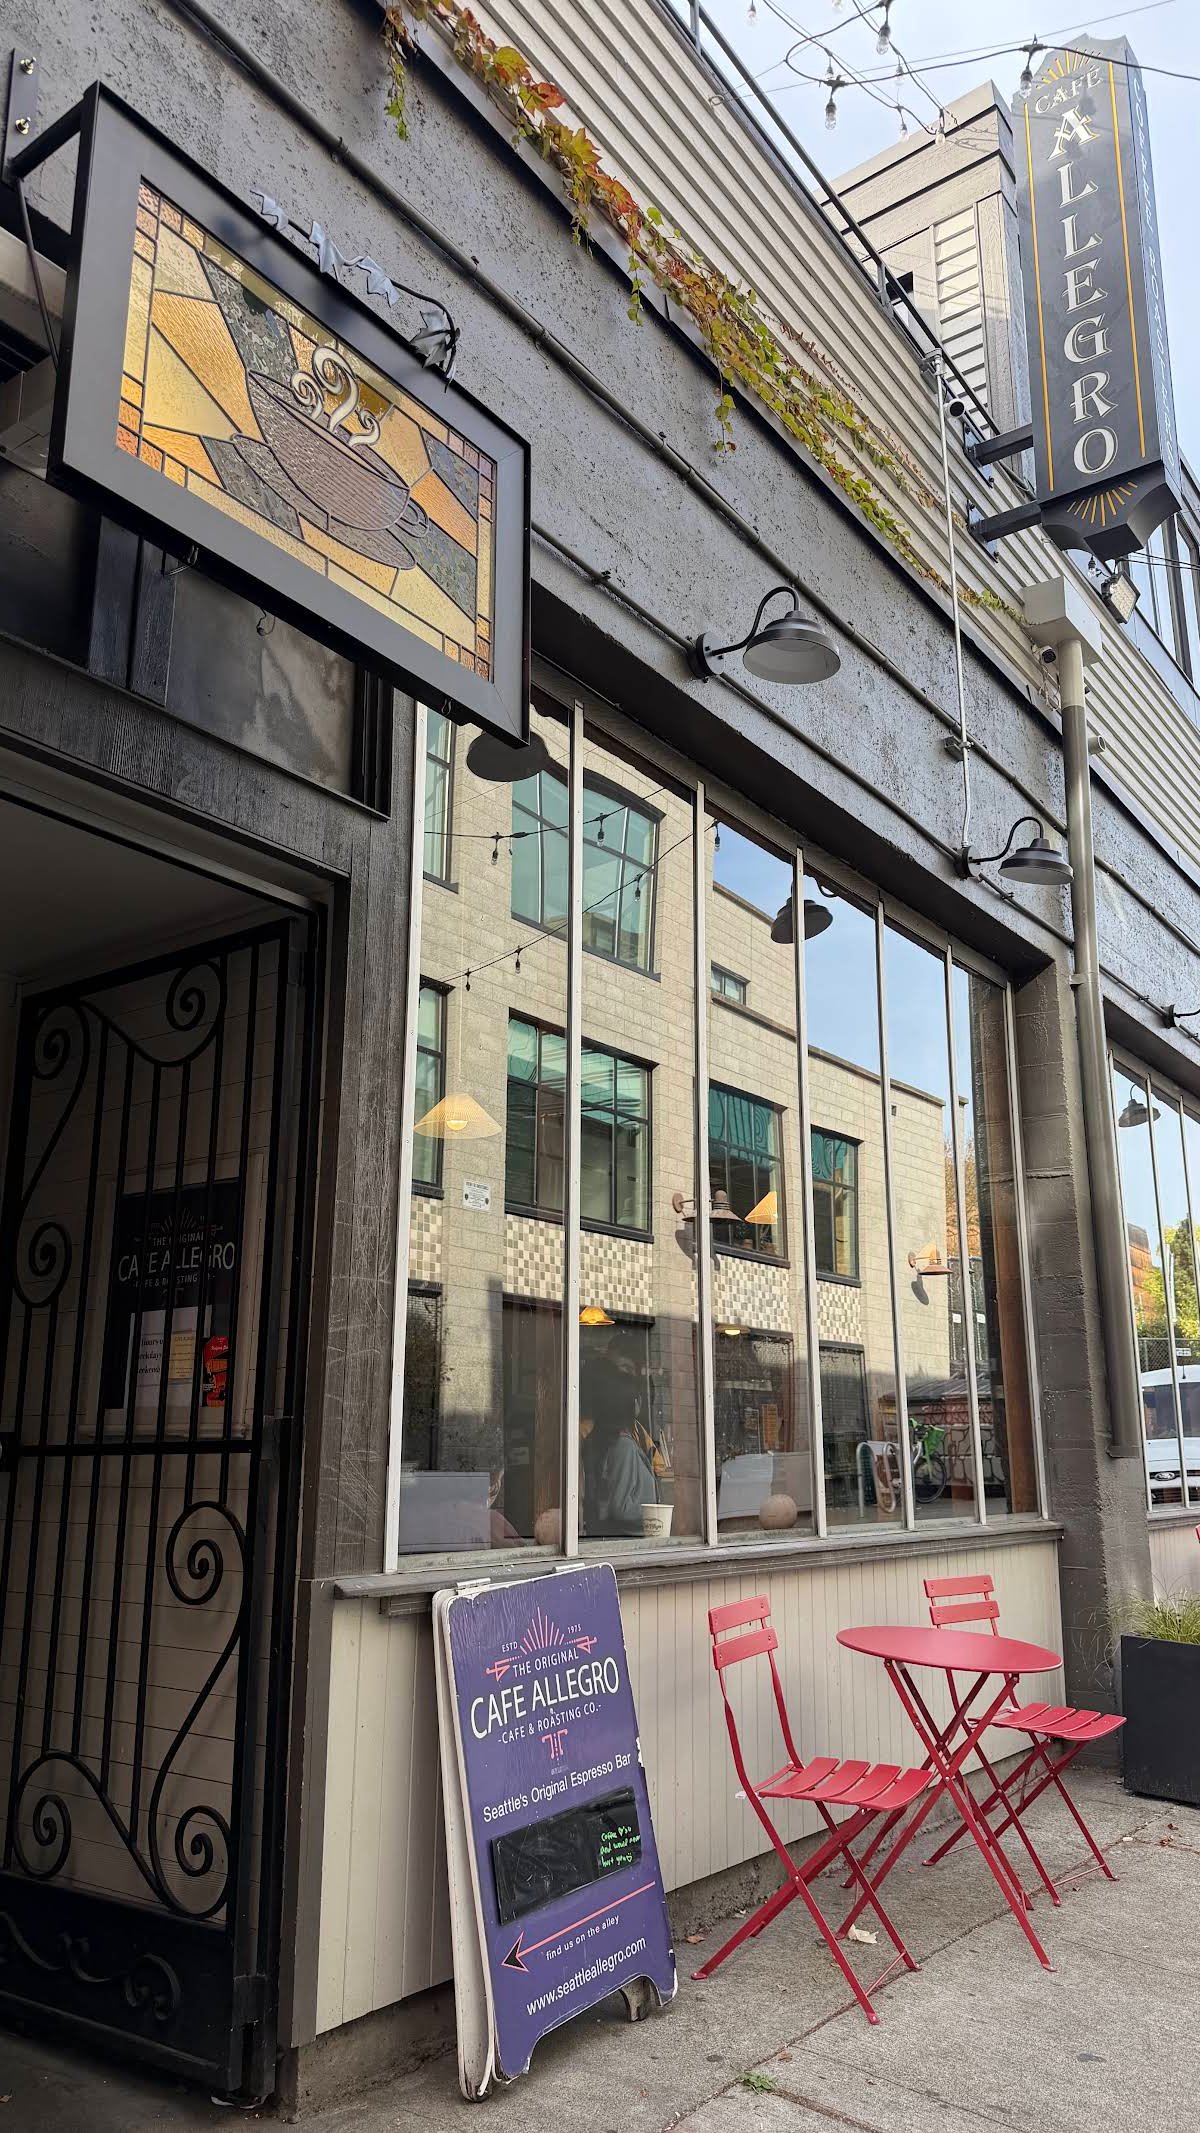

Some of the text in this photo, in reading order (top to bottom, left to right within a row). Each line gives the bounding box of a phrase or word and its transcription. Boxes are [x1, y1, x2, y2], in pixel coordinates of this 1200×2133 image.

[1035, 64, 1103, 114] CAFÉ
[1047, 103, 1119, 477] ALLEGRO
[118, 1251, 158, 1283] CAE
[502, 1623, 582, 1653] ESTD 1975
[512, 1647, 579, 1678] THE ORIGINAL
[470, 1656, 619, 1739] CAFE ALLEGRO
[528, 1721, 535, 1735] &
[537, 1708, 581, 1732] ROASTING
[483, 1794, 529, 1823] Seattle's
[531, 1775, 568, 1802] Original
[570, 1761, 614, 1787] Espresso
[615, 1752, 631, 1769] Bar
[545, 1914, 620, 1961] find us on the alley
[526, 1937, 647, 2016] www.seattleallegro.com
